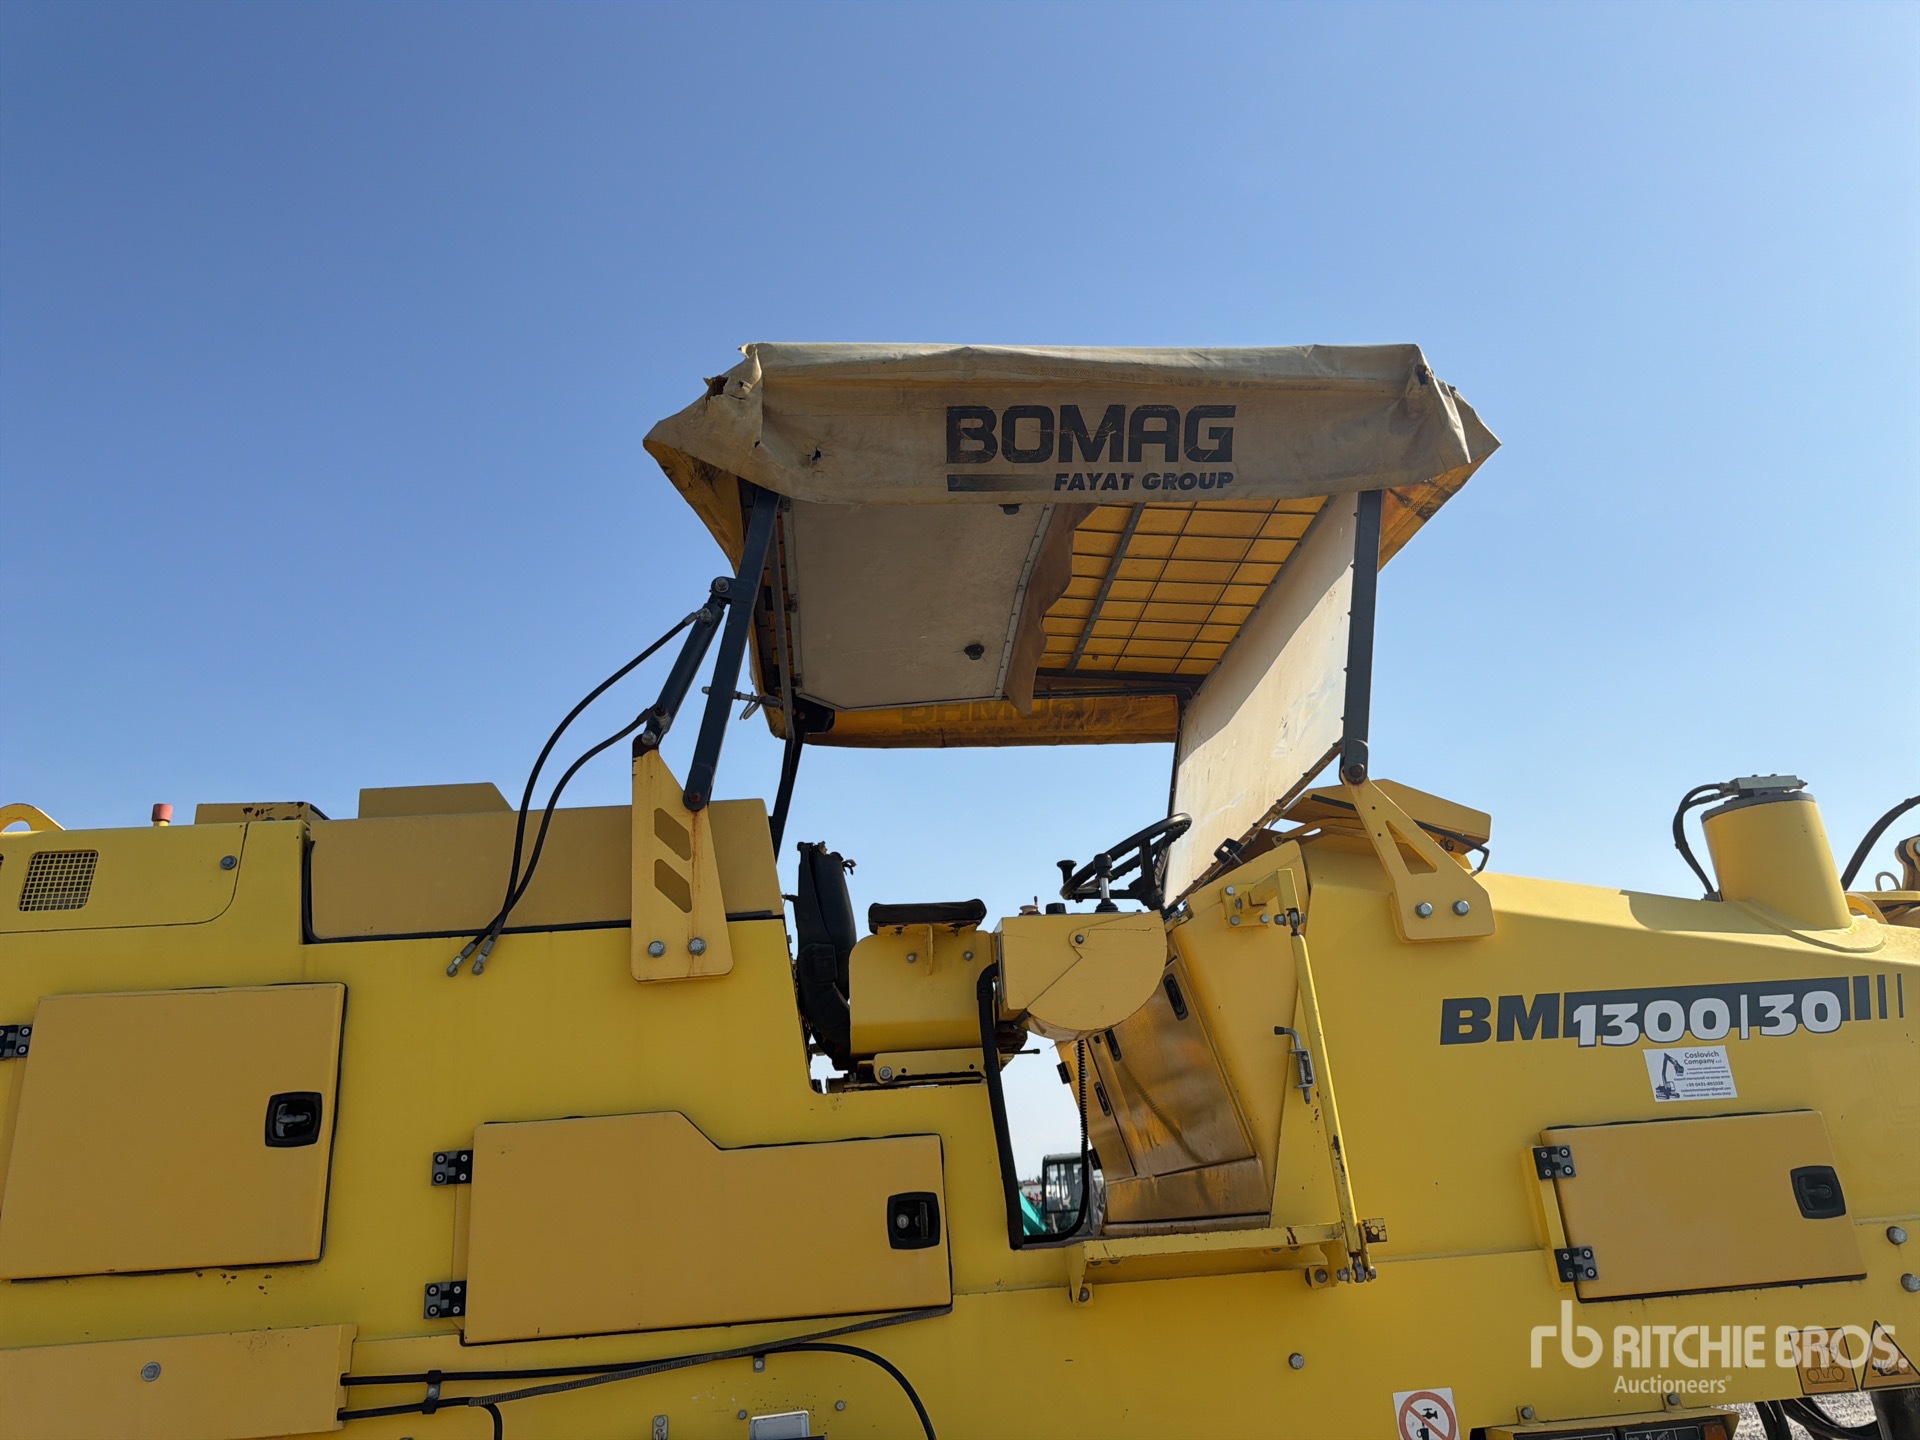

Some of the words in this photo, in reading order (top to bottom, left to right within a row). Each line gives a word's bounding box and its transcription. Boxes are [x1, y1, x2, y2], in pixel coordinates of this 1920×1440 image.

[946, 404, 1236, 463] BOMAG
[1054, 473, 1134, 491] FAYAT
[1142, 472, 1234, 490] GROUP
